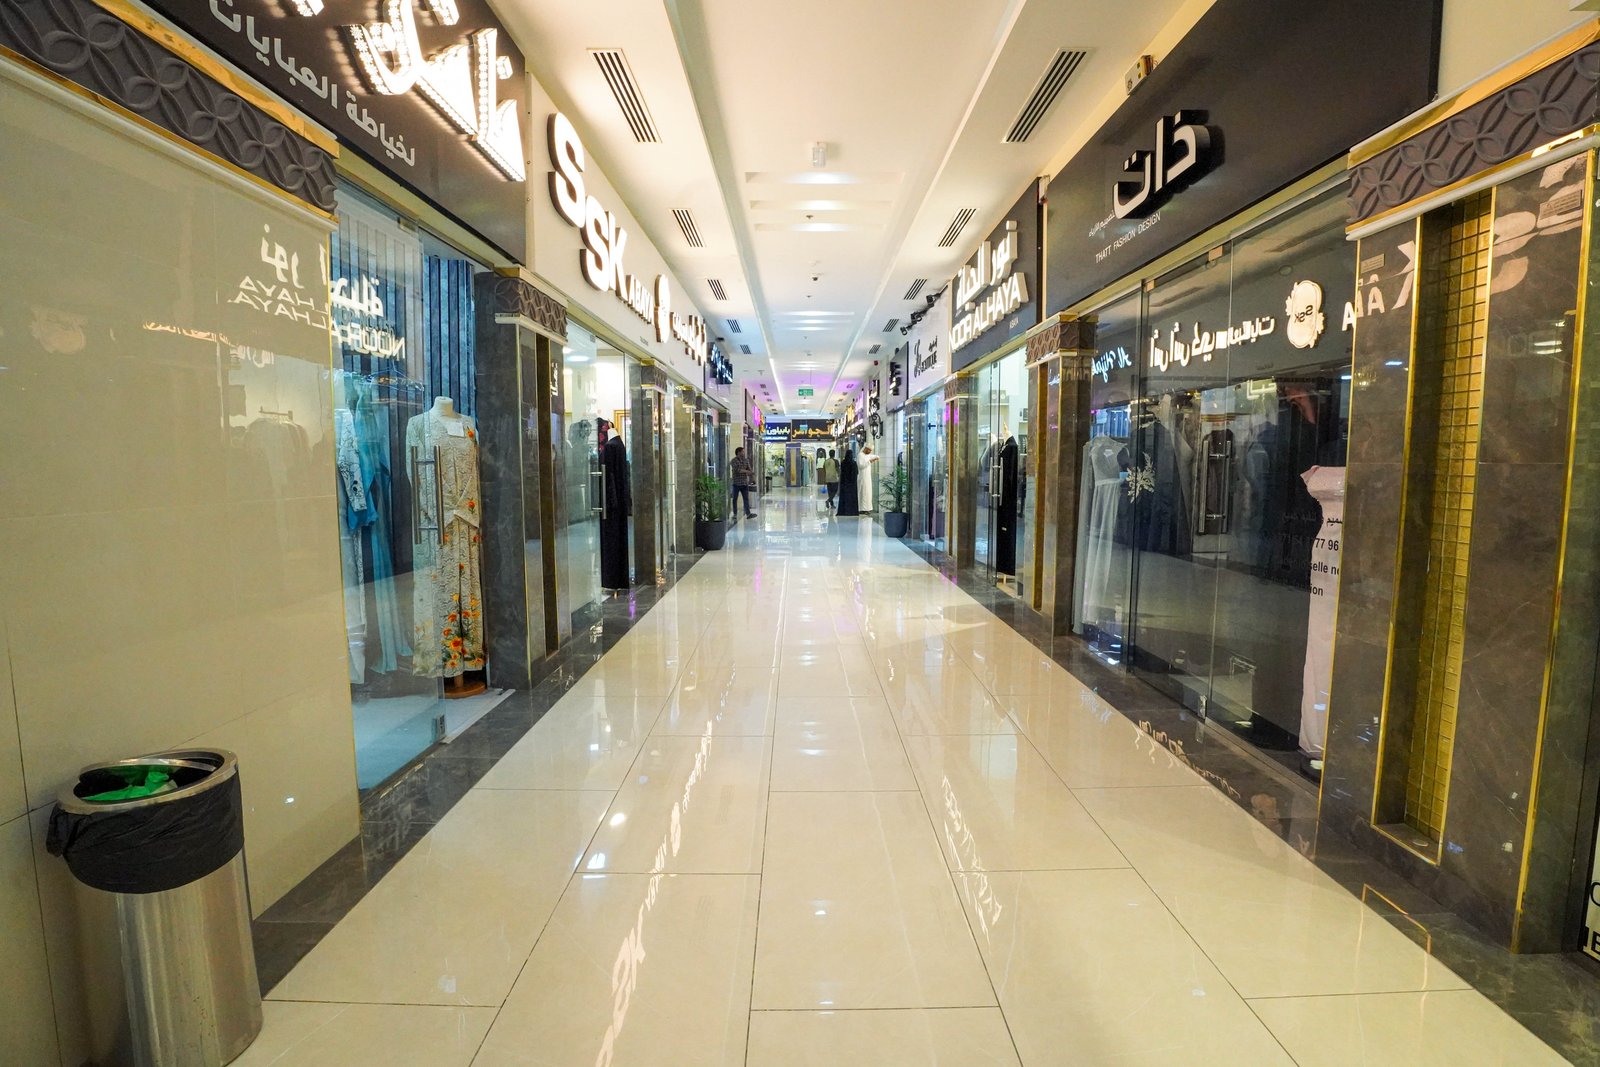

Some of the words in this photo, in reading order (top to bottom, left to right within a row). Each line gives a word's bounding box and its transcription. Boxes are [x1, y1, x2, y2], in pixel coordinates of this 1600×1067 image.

[989, 219, 1019, 287] نور
[1095, 244, 1112, 264] THATT
[1113, 228, 1137, 252] FASHION
[1137, 211, 1161, 235] DESIGN
[948, 312, 976, 353] NOOR
[972, 271, 1030, 340] ALHAYA
